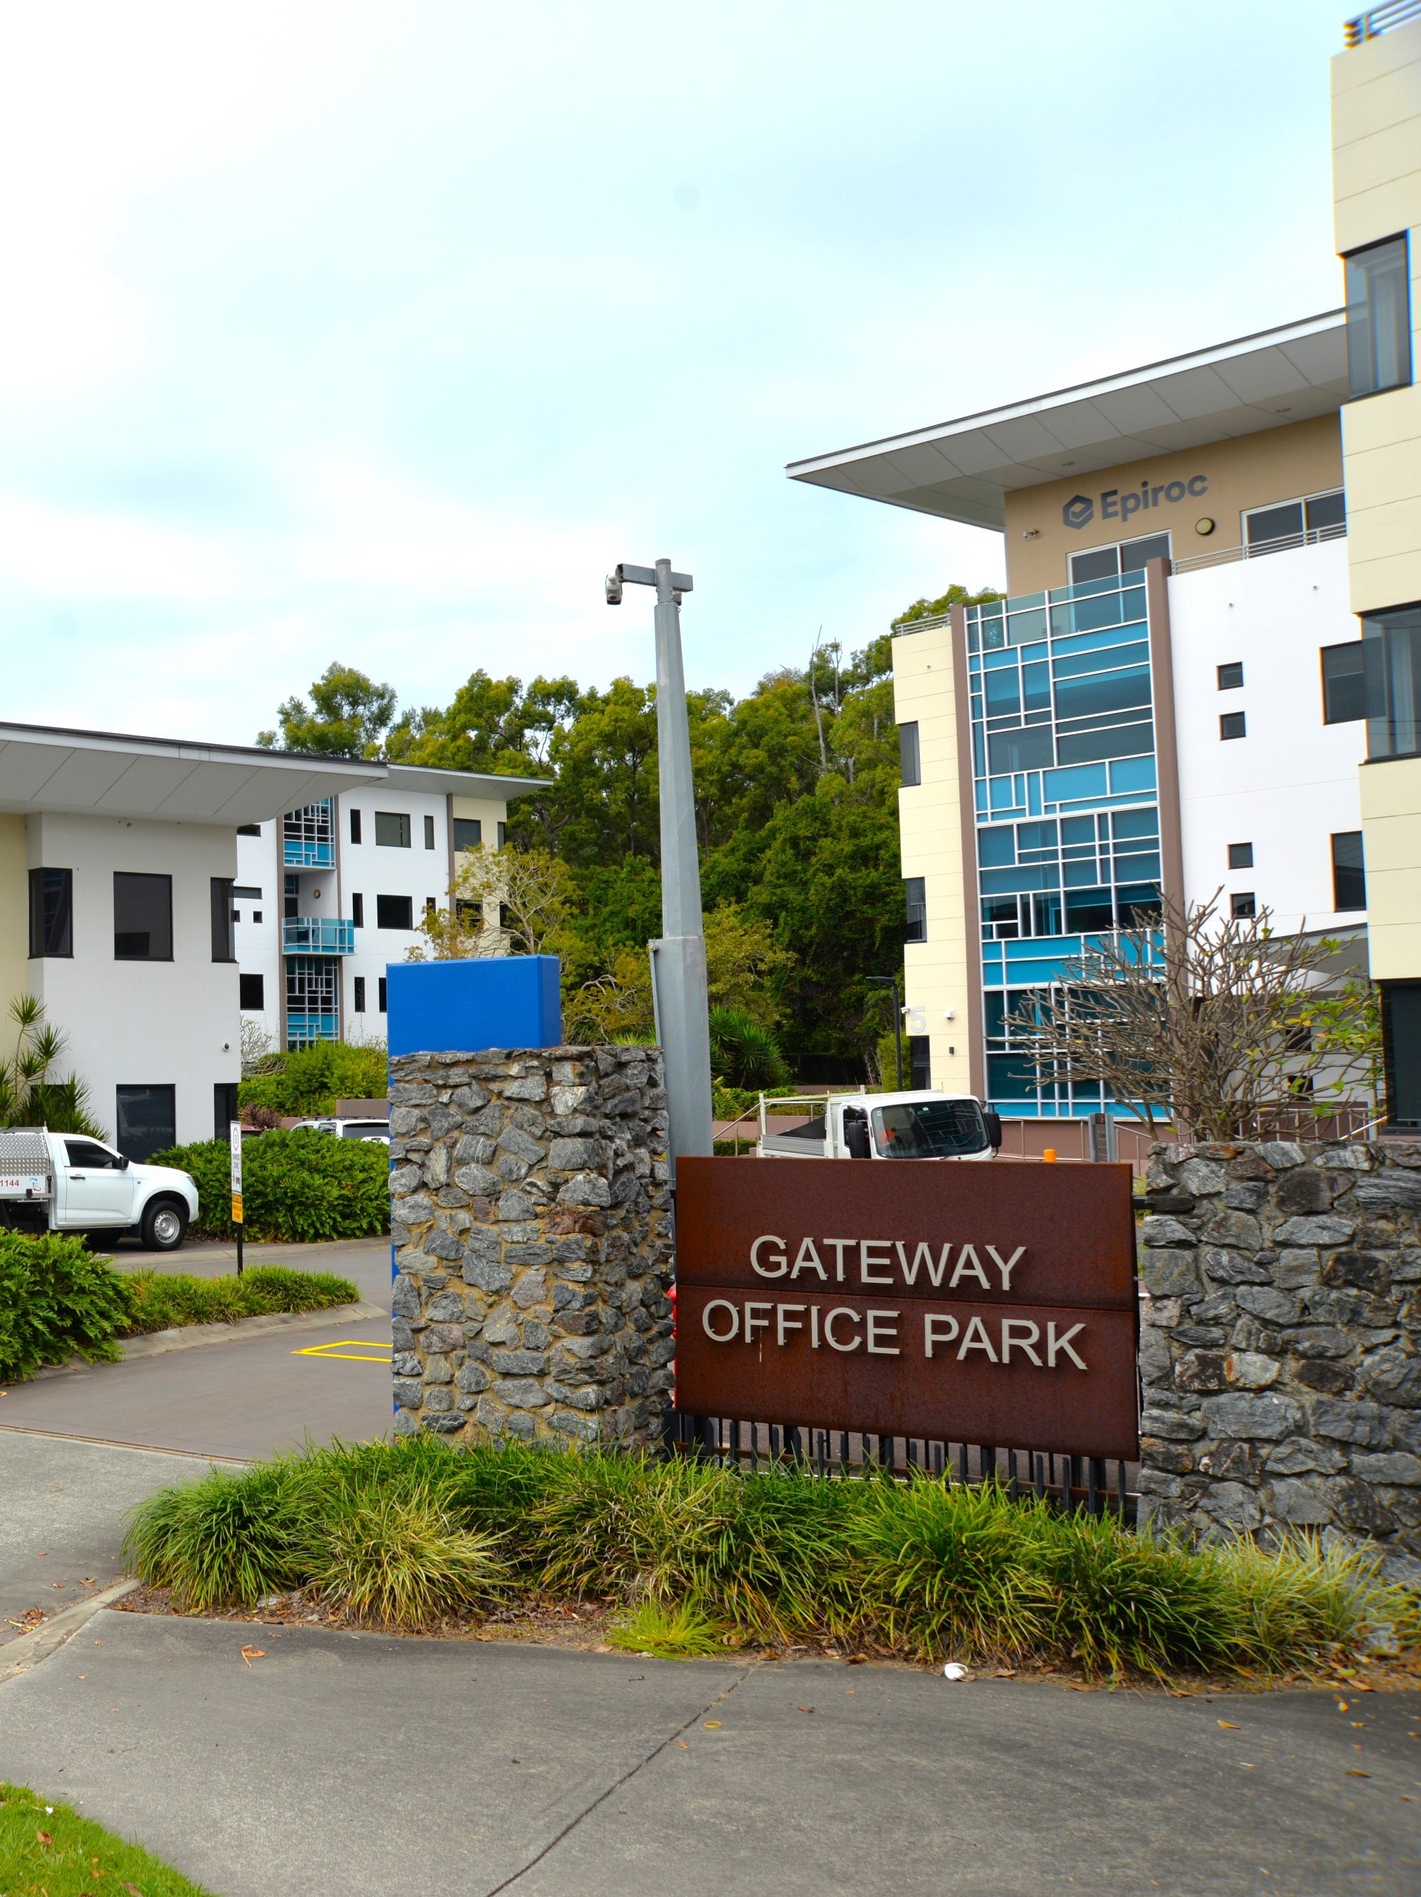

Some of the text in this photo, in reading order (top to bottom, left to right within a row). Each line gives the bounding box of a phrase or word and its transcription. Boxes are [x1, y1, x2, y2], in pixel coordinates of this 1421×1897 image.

[1100, 474, 1209, 523] Epiroc
[910, 1006, 927, 1034] 5
[749, 1234, 1027, 1291] GATEWAY
[702, 1299, 1089, 1370] OFFICE PARK
